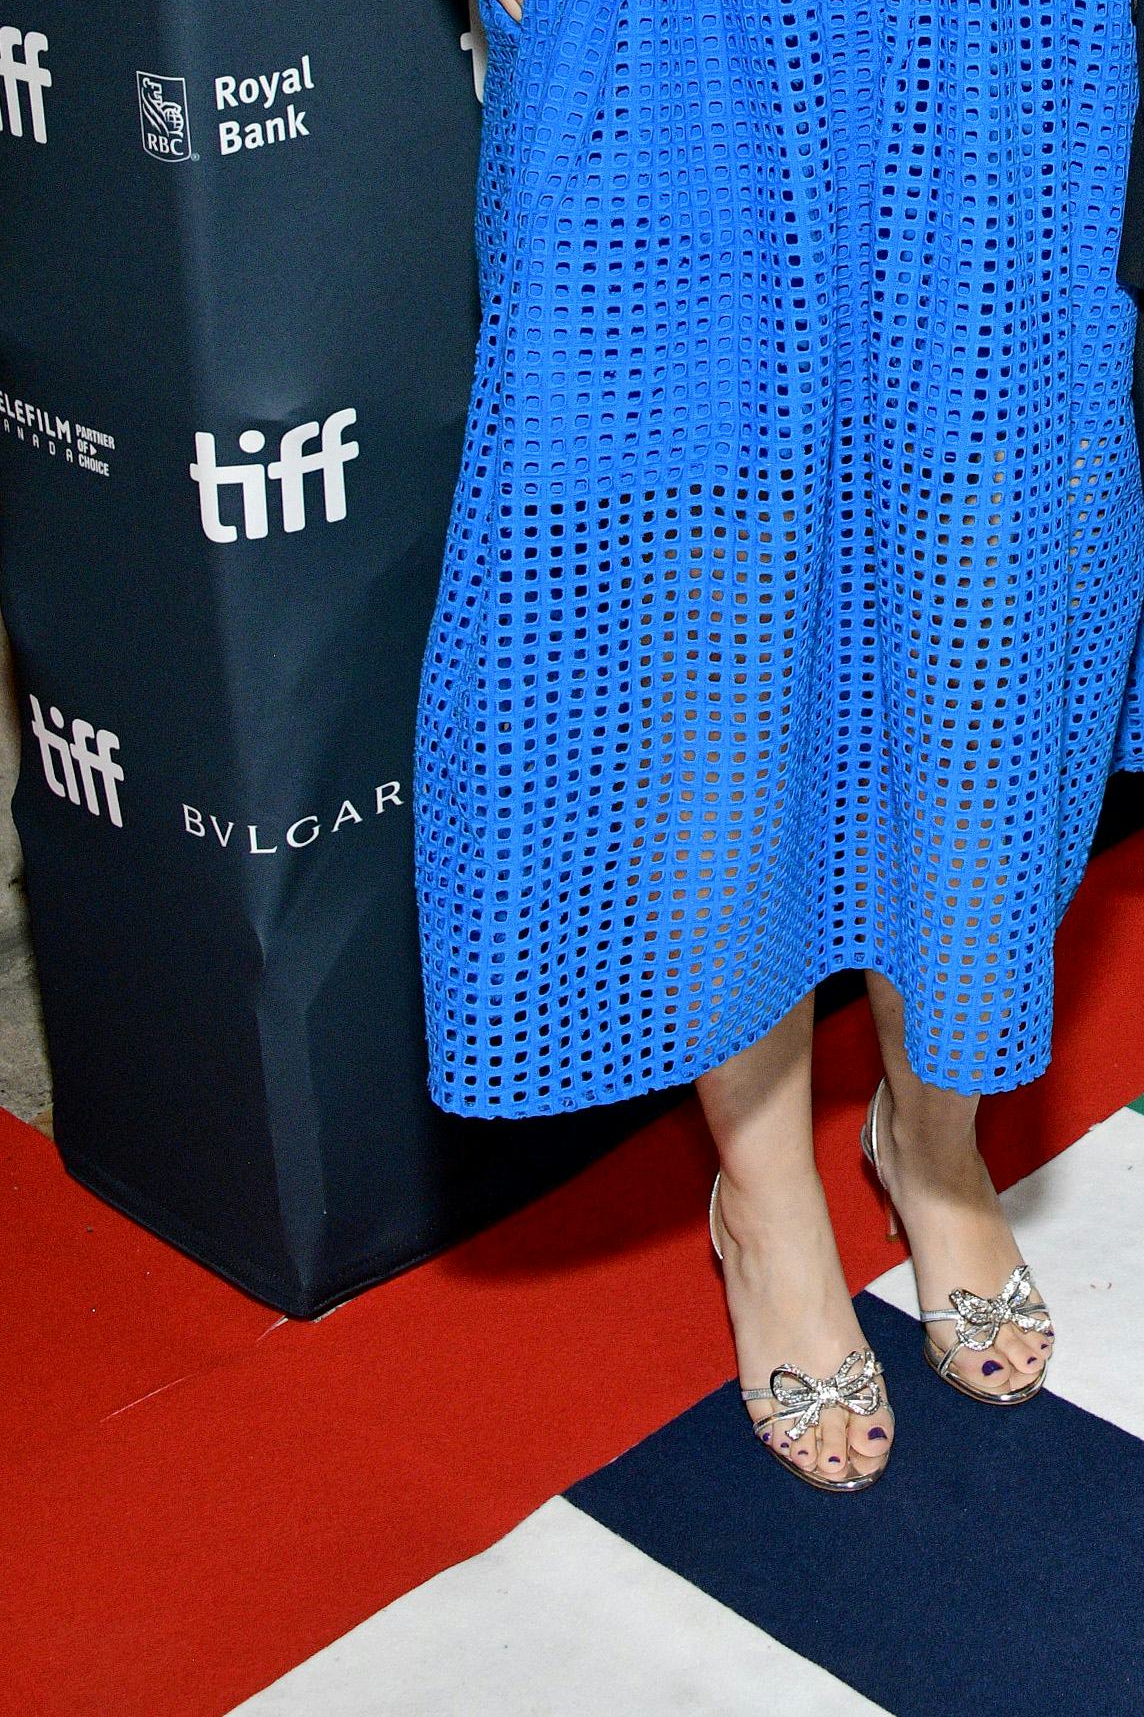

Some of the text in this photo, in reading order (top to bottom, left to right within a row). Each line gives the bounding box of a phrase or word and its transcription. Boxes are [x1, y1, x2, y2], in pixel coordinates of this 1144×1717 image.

[0, 26, 52, 143] ff
[215, 55, 314, 110] Royal
[148, 132, 184, 157] RBC
[217, 106, 310, 155] Bank
[3, 418, 73, 463] ANADA
[75, 423, 116, 450] PARTNER
[76, 438, 88, 454] OF
[78, 453, 110, 477] CHOICE
[190, 408, 359, 543] tiff
[30, 694, 124, 827] tiff
[183, 782, 403, 853] BVLGAR
